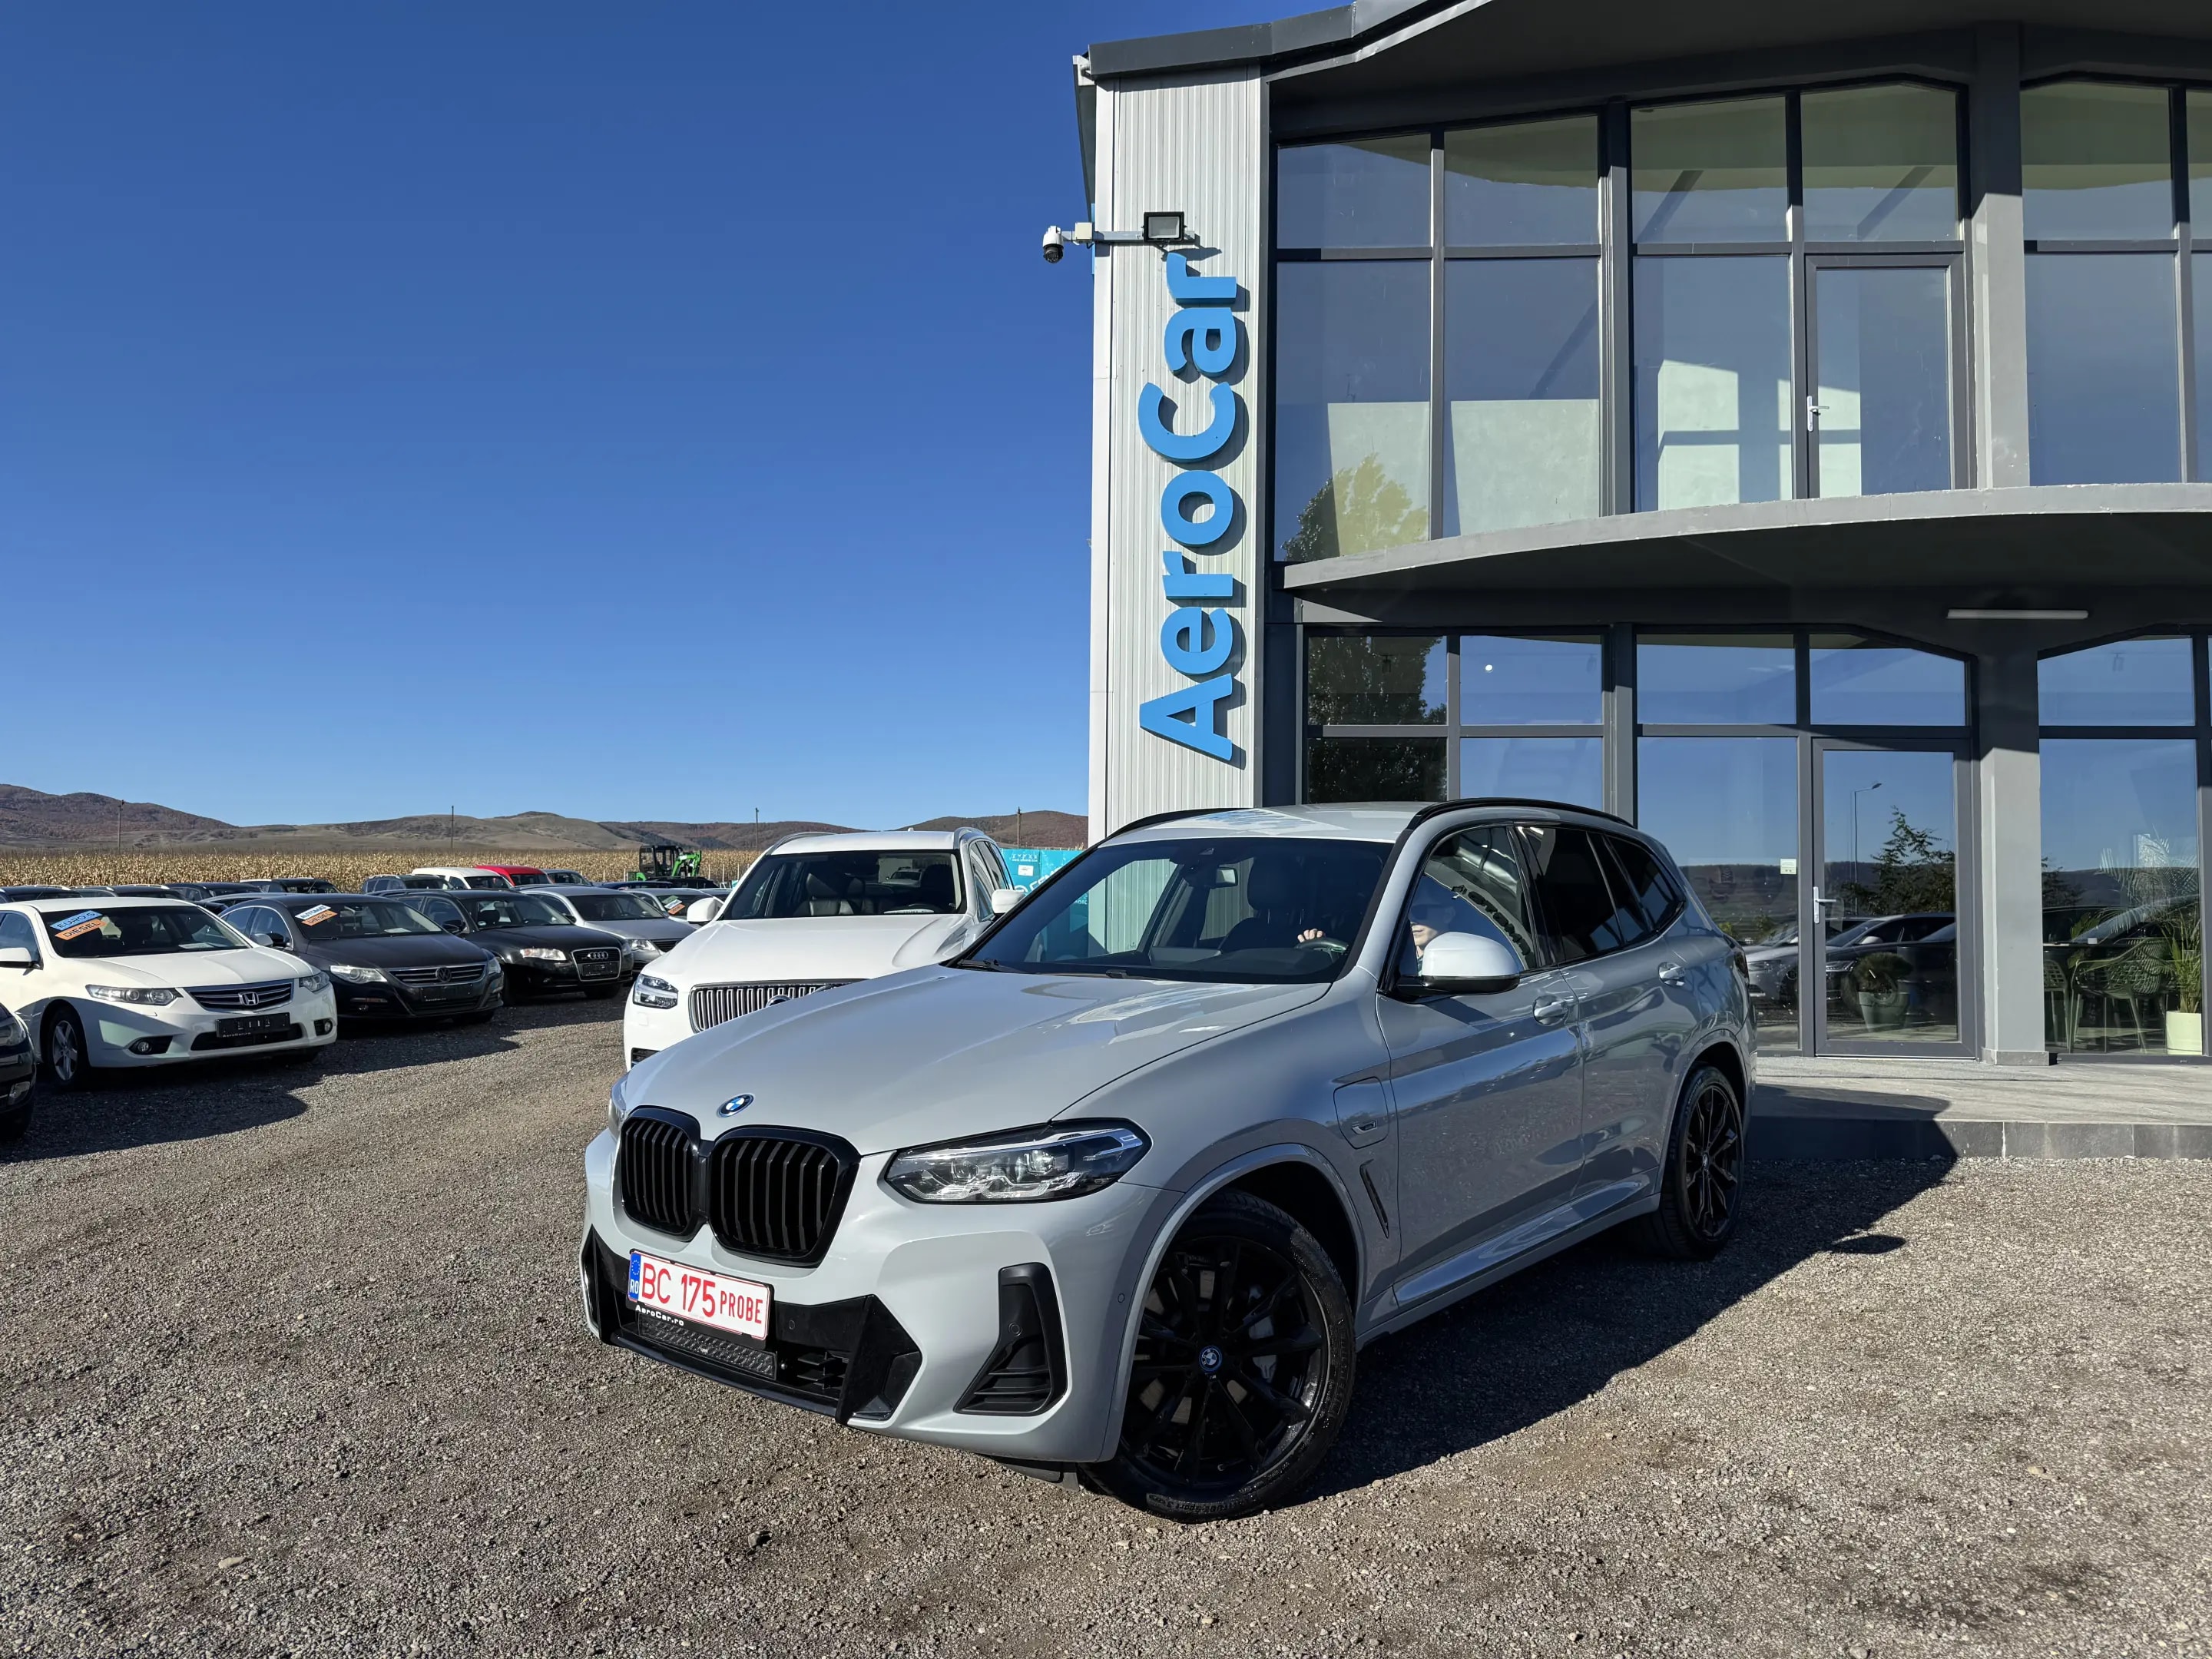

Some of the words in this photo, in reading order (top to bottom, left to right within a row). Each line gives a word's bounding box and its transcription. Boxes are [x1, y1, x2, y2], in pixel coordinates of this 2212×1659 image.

[1138, 253, 1237, 760] AeroCar
[57, 915, 87, 928] EURO
[63, 922, 101, 937] DIESEL
[630, 1280, 640, 1294] RO
[641, 1262, 672, 1304] BC
[680, 1273, 716, 1317] 175
[720, 1290, 763, 1324] PROBE
[635, 1304, 684, 1326] AeroCar.ro
